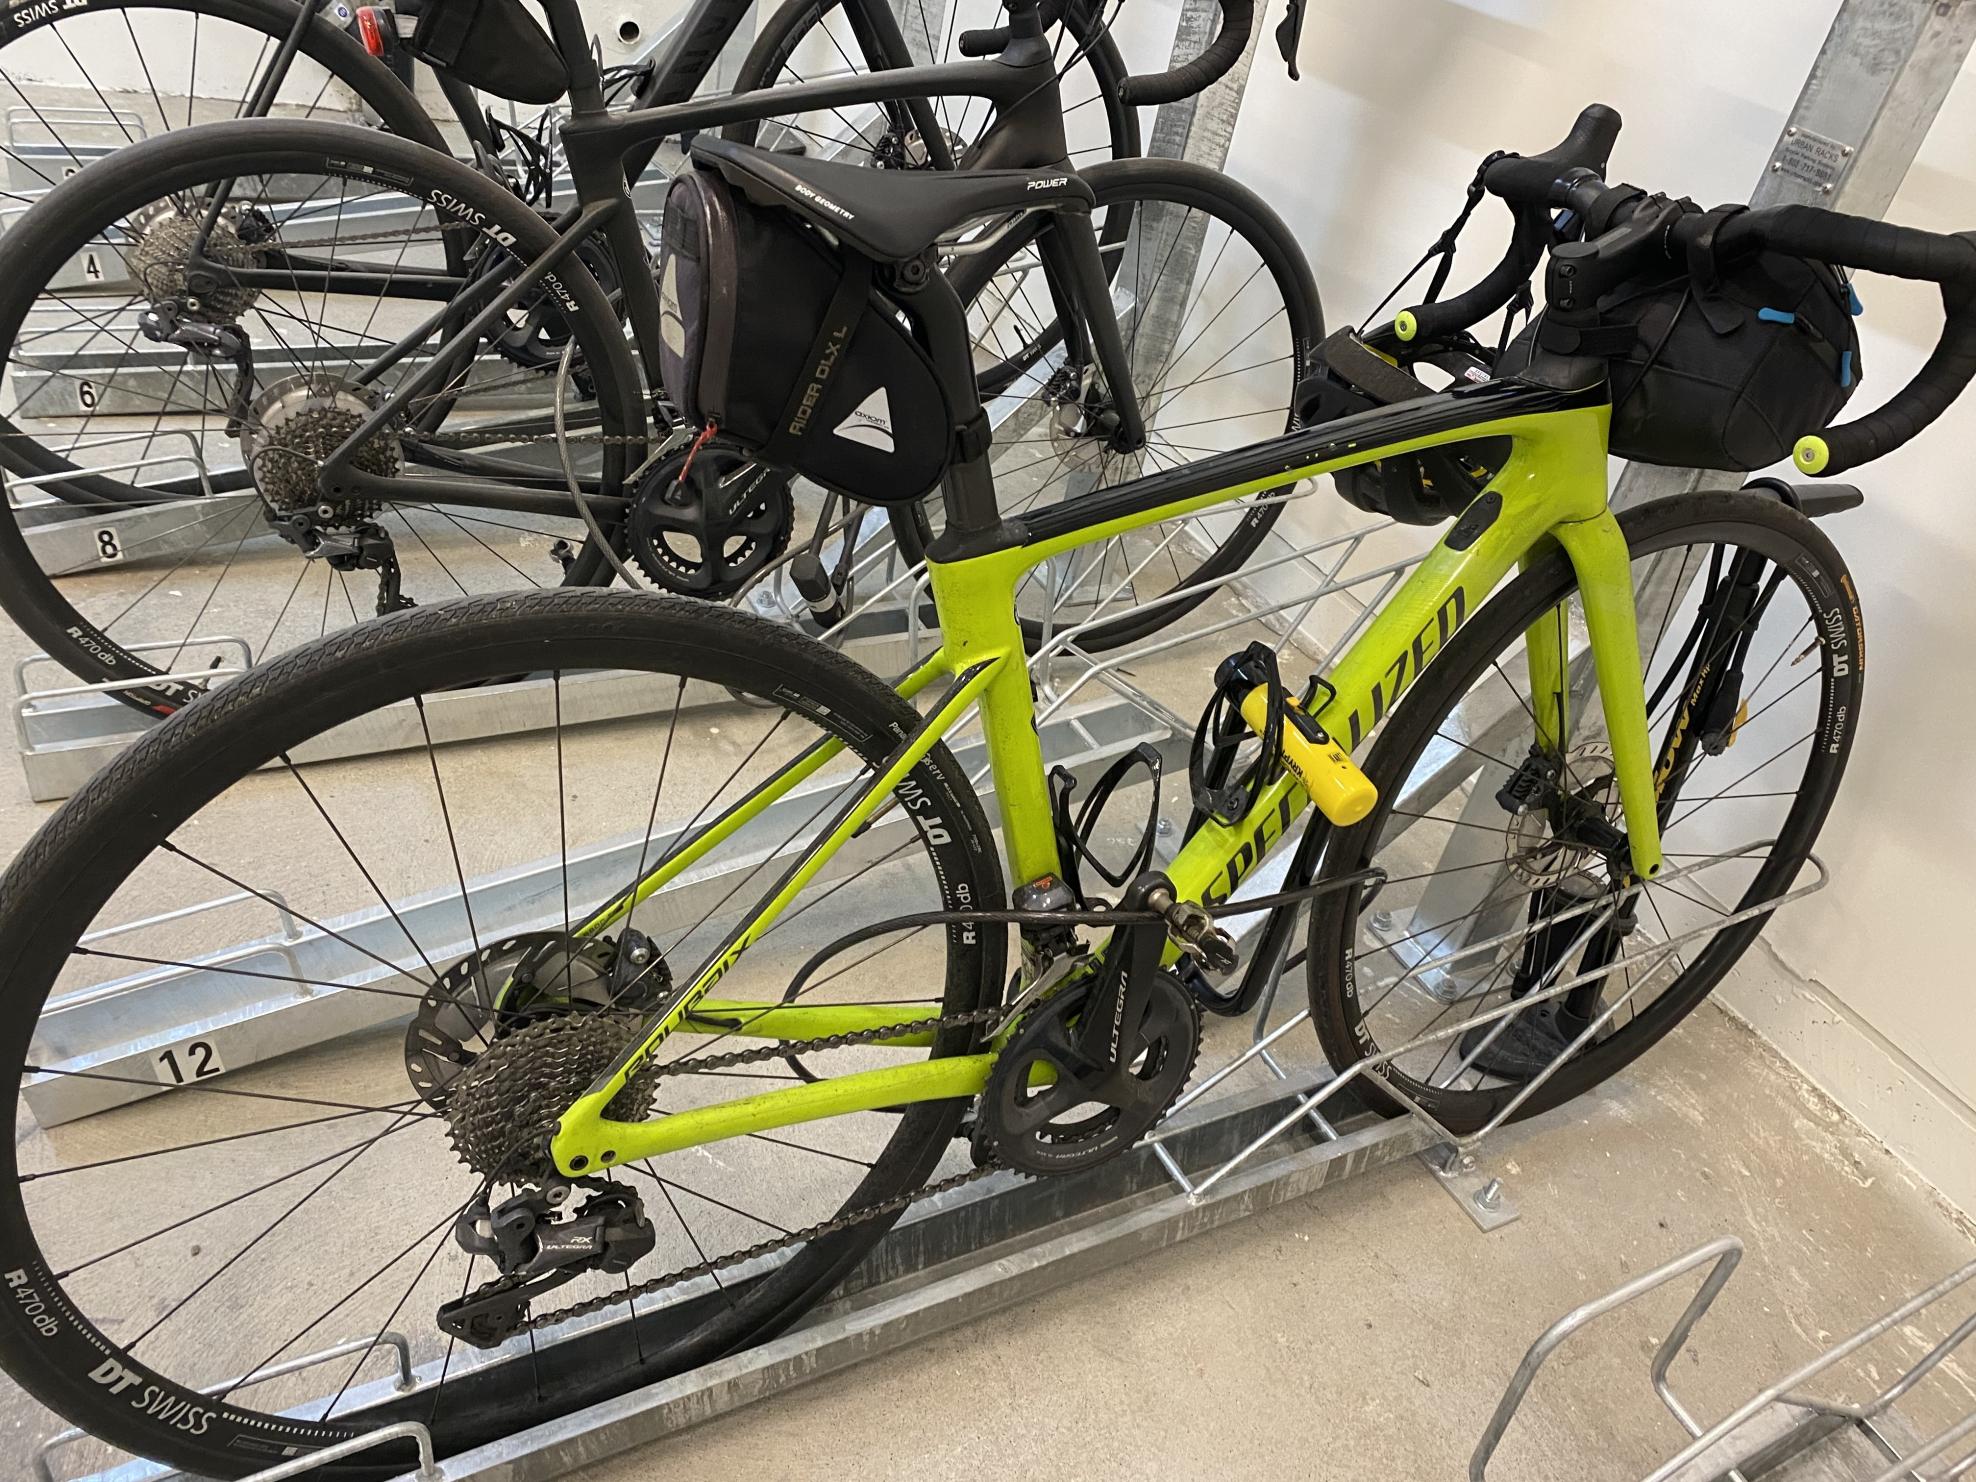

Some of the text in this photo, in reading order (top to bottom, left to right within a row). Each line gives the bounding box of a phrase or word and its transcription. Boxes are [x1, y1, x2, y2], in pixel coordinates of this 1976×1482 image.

[795, 184, 855, 221] BODY GEOMETRY
[1027, 177, 1068, 191] POWER
[426, 189, 518, 247] DT SWISS
[86, 254, 101, 279] 4
[543, 271, 580, 312] R470d
[79, 381, 96, 408] 6
[789, 382, 823, 435] RIDER
[833, 325, 848, 339] L
[854, 410, 886, 426] axiom
[97, 529, 118, 559] 8
[66, 625, 117, 666] R470db
[1823, 607, 1849, 677] DT SWISS
[1690, 676, 1708, 707] Max
[1829, 705, 1847, 754] R470db
[916, 815, 953, 846] DT
[1109, 970, 1128, 1064] ULTEGRA
[158, 1041, 221, 1084] 12
[1364, 1041, 1393, 1082] SISS
[570, 1236, 593, 1244] RX
[4, 1268, 60, 1337] R470db
[87, 1357, 217, 1435] DT SWISS
